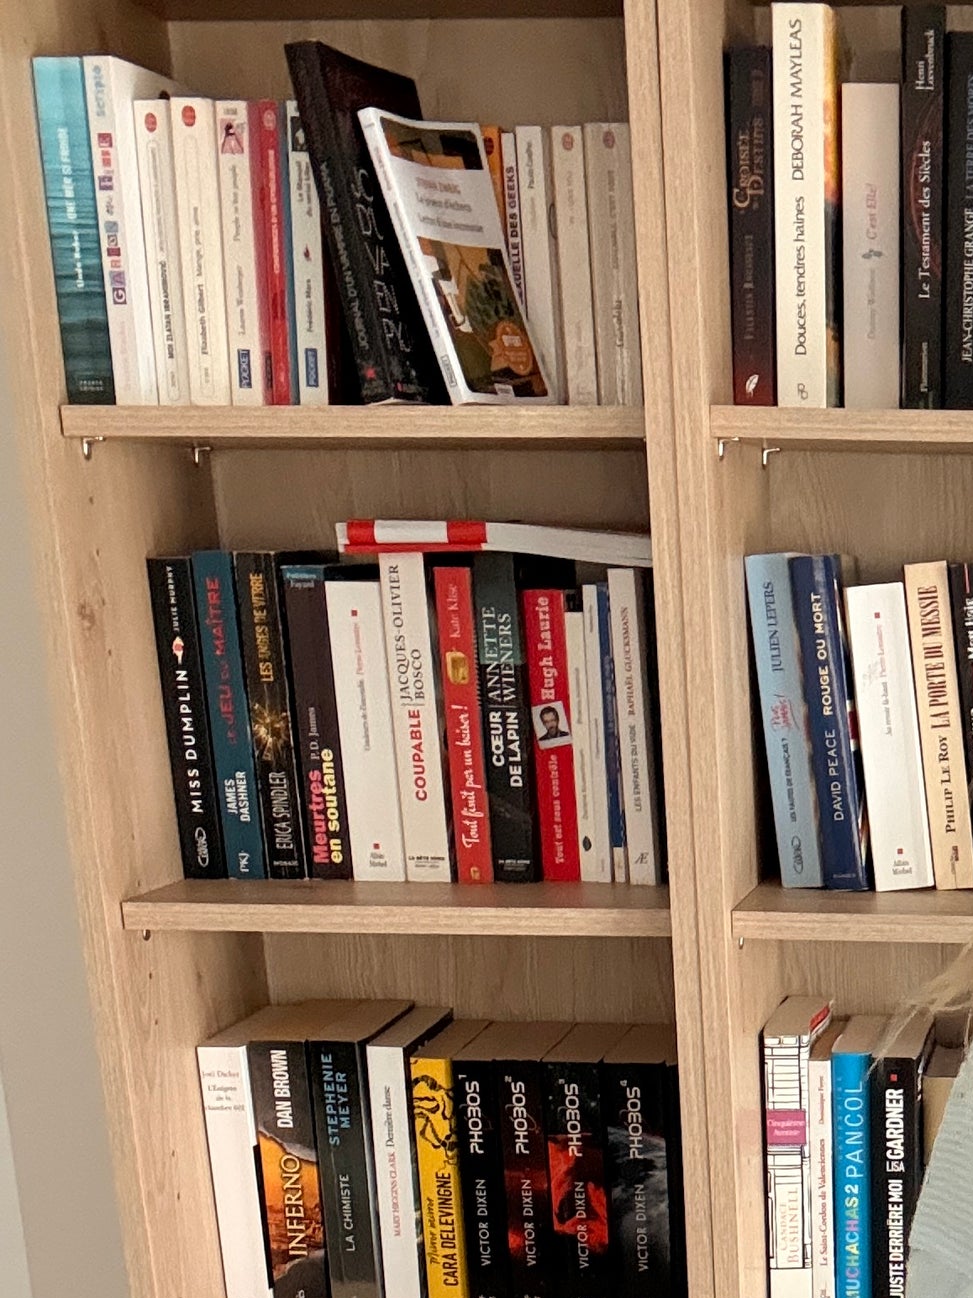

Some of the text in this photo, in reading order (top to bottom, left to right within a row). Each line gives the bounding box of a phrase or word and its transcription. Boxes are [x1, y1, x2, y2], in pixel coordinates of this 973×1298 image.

[790, 103, 805, 181] DEBORAH
[506, 166, 518, 238] DES GEEKS
[917, 140, 932, 299] Le Testament des Siècles
[345, 270, 357, 297] D'UN
[792, 196, 806, 297] tendres haines
[197, 284, 206, 313] Gilbert
[351, 300, 369, 349] JOURNAL
[388, 564, 413, 702] JACQUES-OLIVIER
[448, 614, 462, 639] Kate
[481, 606, 503, 700] ANNETTE
[498, 613, 516, 702] WIENERS
[535, 596, 555, 701] Hugh Laurie
[621, 606, 634, 672] GLUCKSMANN
[764, 581, 785, 672] JULIEN LEPERS
[810, 592, 834, 715] ROUGE OU MORT
[917, 585, 951, 729] LA PORTE DU MESSIE
[220, 684, 235, 725] JEU
[259, 661, 274, 682] LES
[410, 648, 426, 700] BOSCO
[175, 669, 198, 760] DUMPLIN
[308, 707, 319, 736] James
[488, 711, 506, 767] CŒUR
[505, 712, 523, 787] DE LAPIN
[188, 767, 203, 813] MISS
[407, 709, 428, 801] COUPABLE
[631, 757, 641, 795] ENFANTS
[825, 729, 845, 821] DAVID PEACE
[936, 735, 957, 833] PHILIP ROY
[224, 779, 237, 814] JAMES
[235, 771, 251, 822] DASHNER
[269, 771, 294, 850] ERICA SPINDLER
[308, 769, 329, 864] Meurtres
[321, 748, 343, 864] en soutane
[459, 749, 480, 848] Tout par un
[555, 840, 565, 864] Tout
[270, 1049, 294, 1129] DAN BROWN
[321, 1053, 341, 1145] STEPHENIE
[335, 1072, 351, 1128] MEYER
[465, 1080, 484, 1154] PHOBOS
[510, 1081, 530, 1154] PHOBOS
[565, 1083, 582, 1157] PHOBOS
[627, 1086, 644, 1159] PHOBOS
[886, 1088, 904, 1160] GARDNER
[388, 1151, 398, 1179] CLARK
[843, 1080, 865, 1178] PANCOL
[885, 1161, 906, 1172] LISA
[280, 1154, 310, 1257] INFERNO
[339, 1174, 356, 1251] LA CHIMISTE
[475, 1179, 492, 1266] VICTOR DIXEN
[521, 1179, 537, 1266] VICTOR DIXEN
[574, 1181, 590, 1269] VICTOR DIXEN
[778, 1201, 789, 1251] CANDACE
[786, 1187, 801, 1263] BUSHNELL
[845, 1184, 859, 1194] 2
[435, 1172, 460, 1287] CARA DELEVINGNE
[634, 1184, 650, 1272] VICTOR DIXEN
[817, 1190, 828, 1266] Le Saint-Cordon de
[886, 1179, 905, 1298] JUSTE DERRIÈRE MOI
